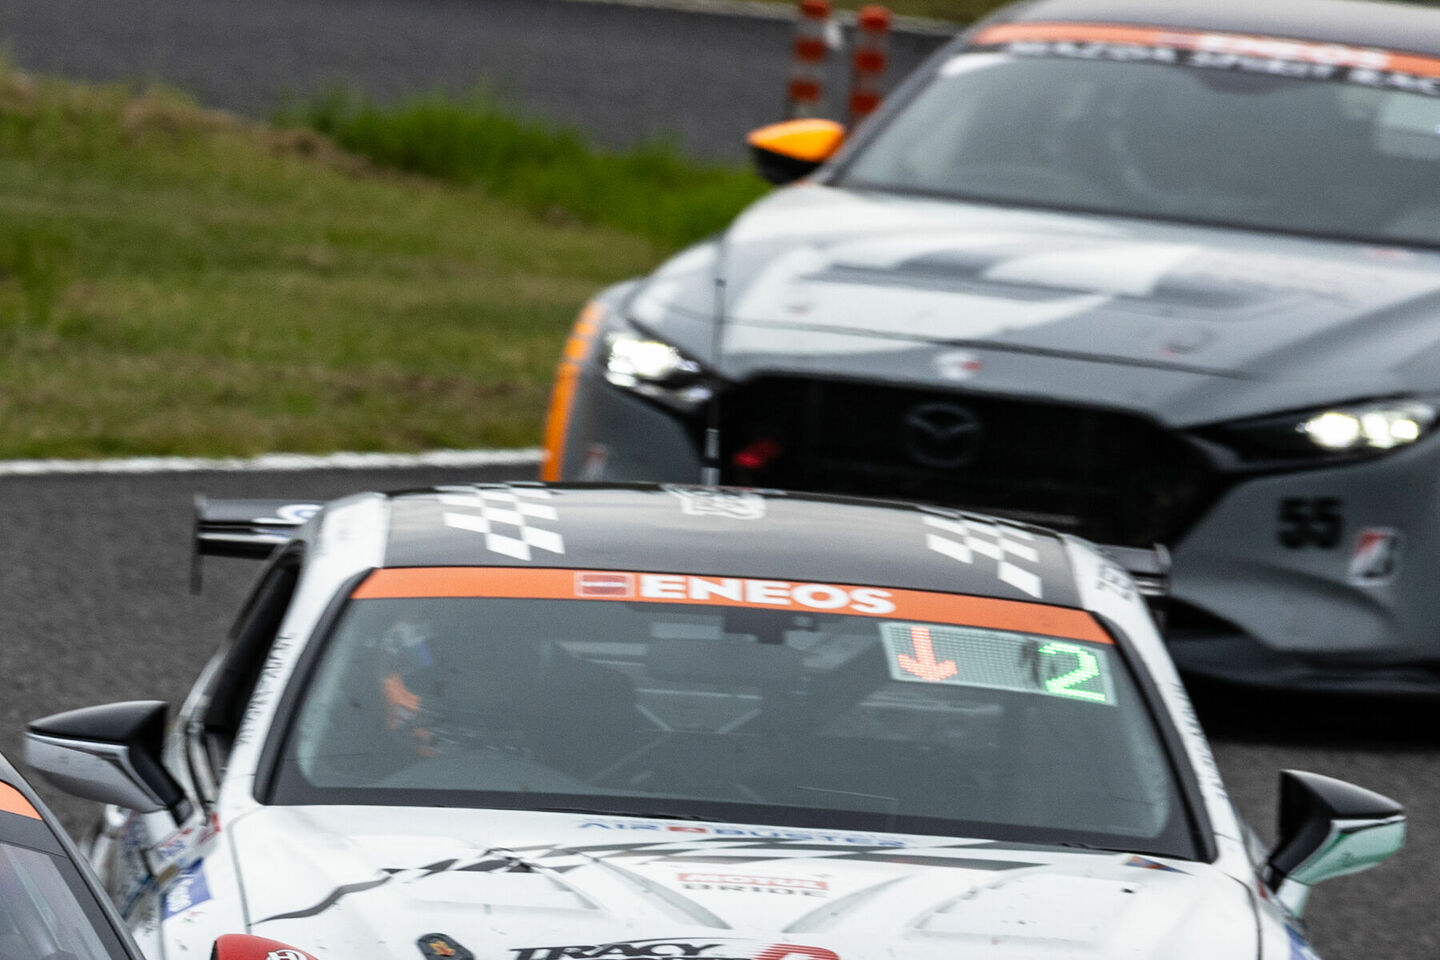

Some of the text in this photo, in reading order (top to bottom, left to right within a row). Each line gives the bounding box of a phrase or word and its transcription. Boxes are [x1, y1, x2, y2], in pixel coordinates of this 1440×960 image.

[1277, 497, 1344, 549] 55
[640, 575, 895, 614] ENEOS
[1038, 642, 1106, 702] 2
